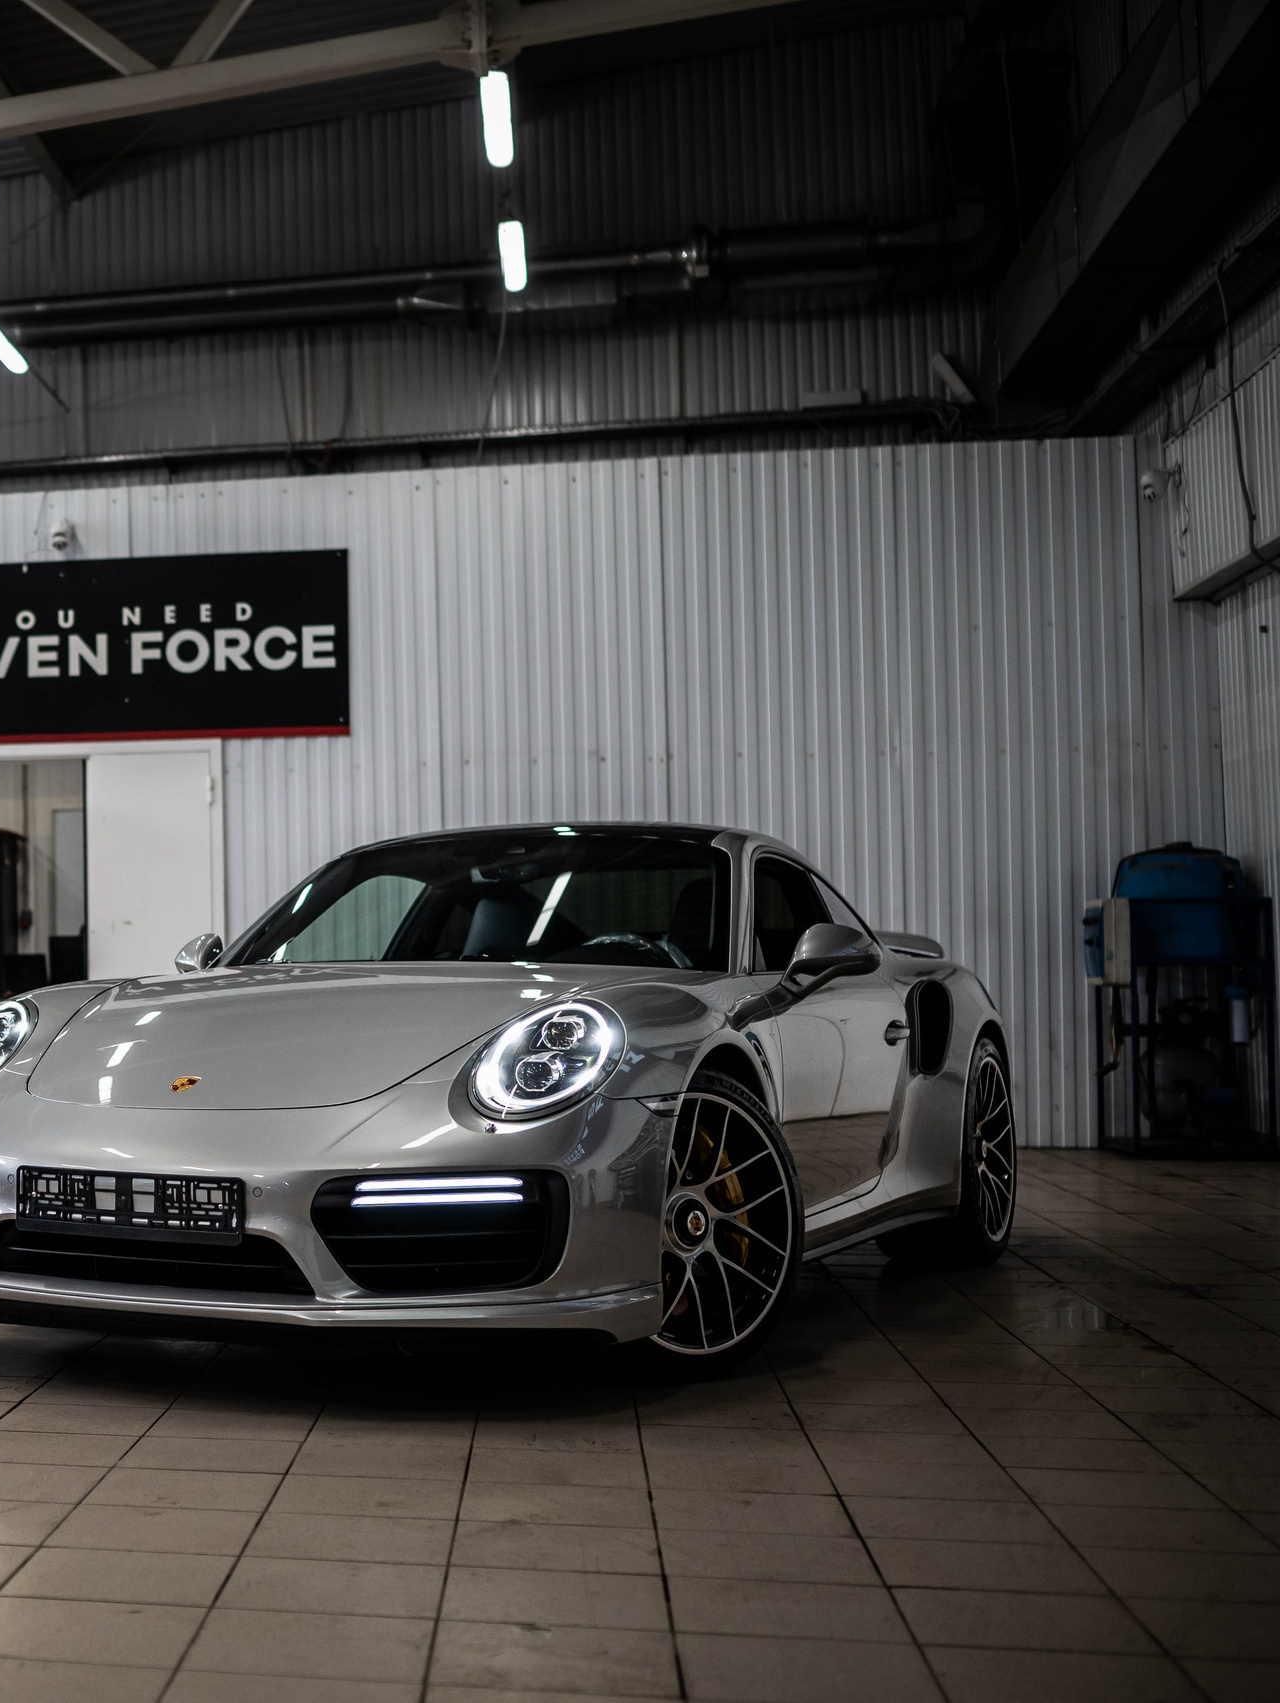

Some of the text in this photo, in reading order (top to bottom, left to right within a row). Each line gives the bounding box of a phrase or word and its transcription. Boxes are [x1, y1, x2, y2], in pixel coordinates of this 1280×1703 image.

[121, 602, 254, 626] NEED
[130, 624, 337, 675] FORCE
[721, 1080, 773, 1122] MICHELIN
